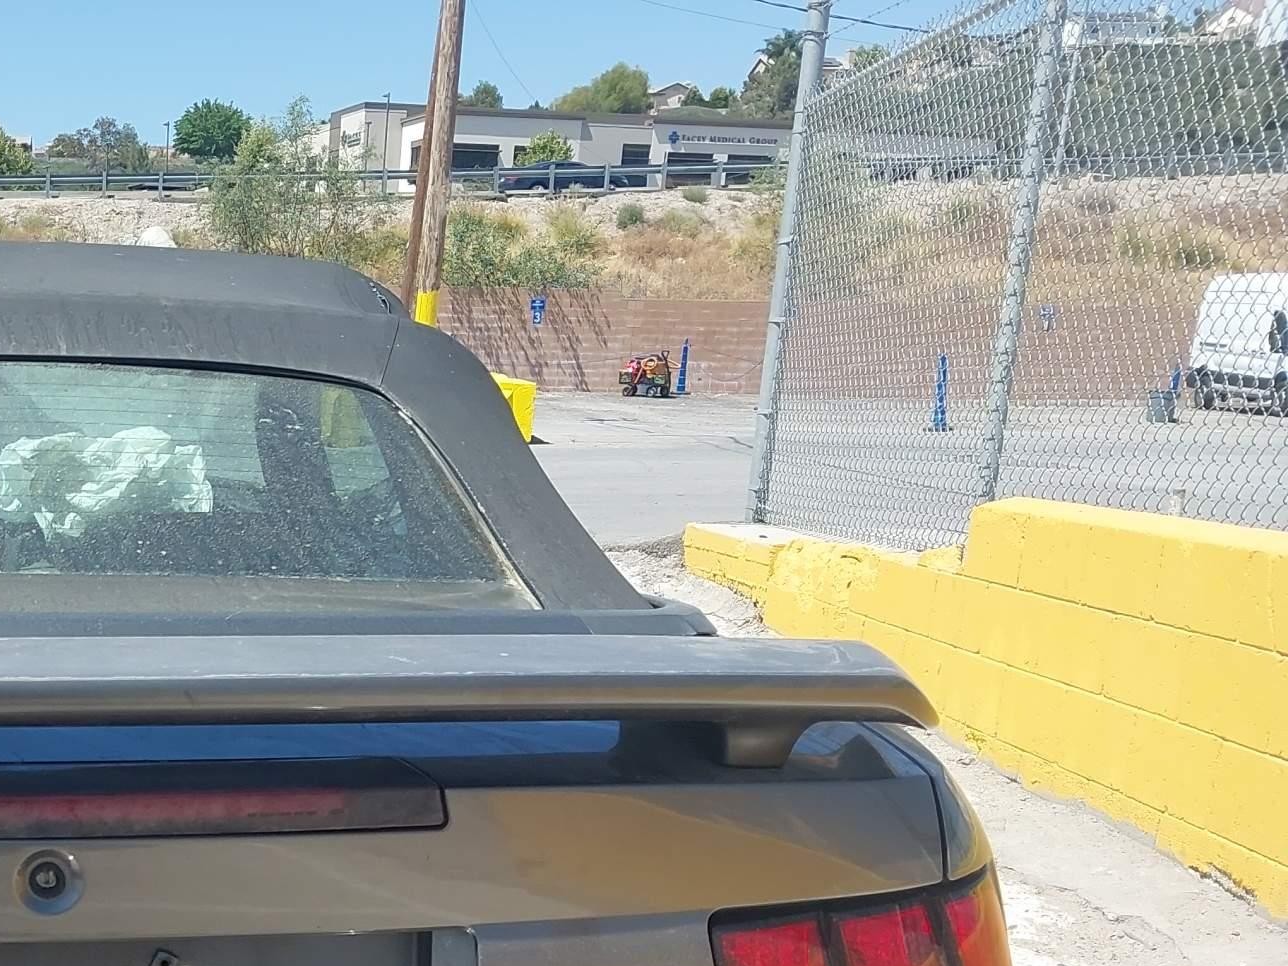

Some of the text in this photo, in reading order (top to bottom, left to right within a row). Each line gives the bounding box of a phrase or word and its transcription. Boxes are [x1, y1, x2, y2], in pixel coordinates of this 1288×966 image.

[709, 135, 746, 144] MEDICAL
[748, 136, 778, 145] GROUP
[534, 311, 541, 323] 3
